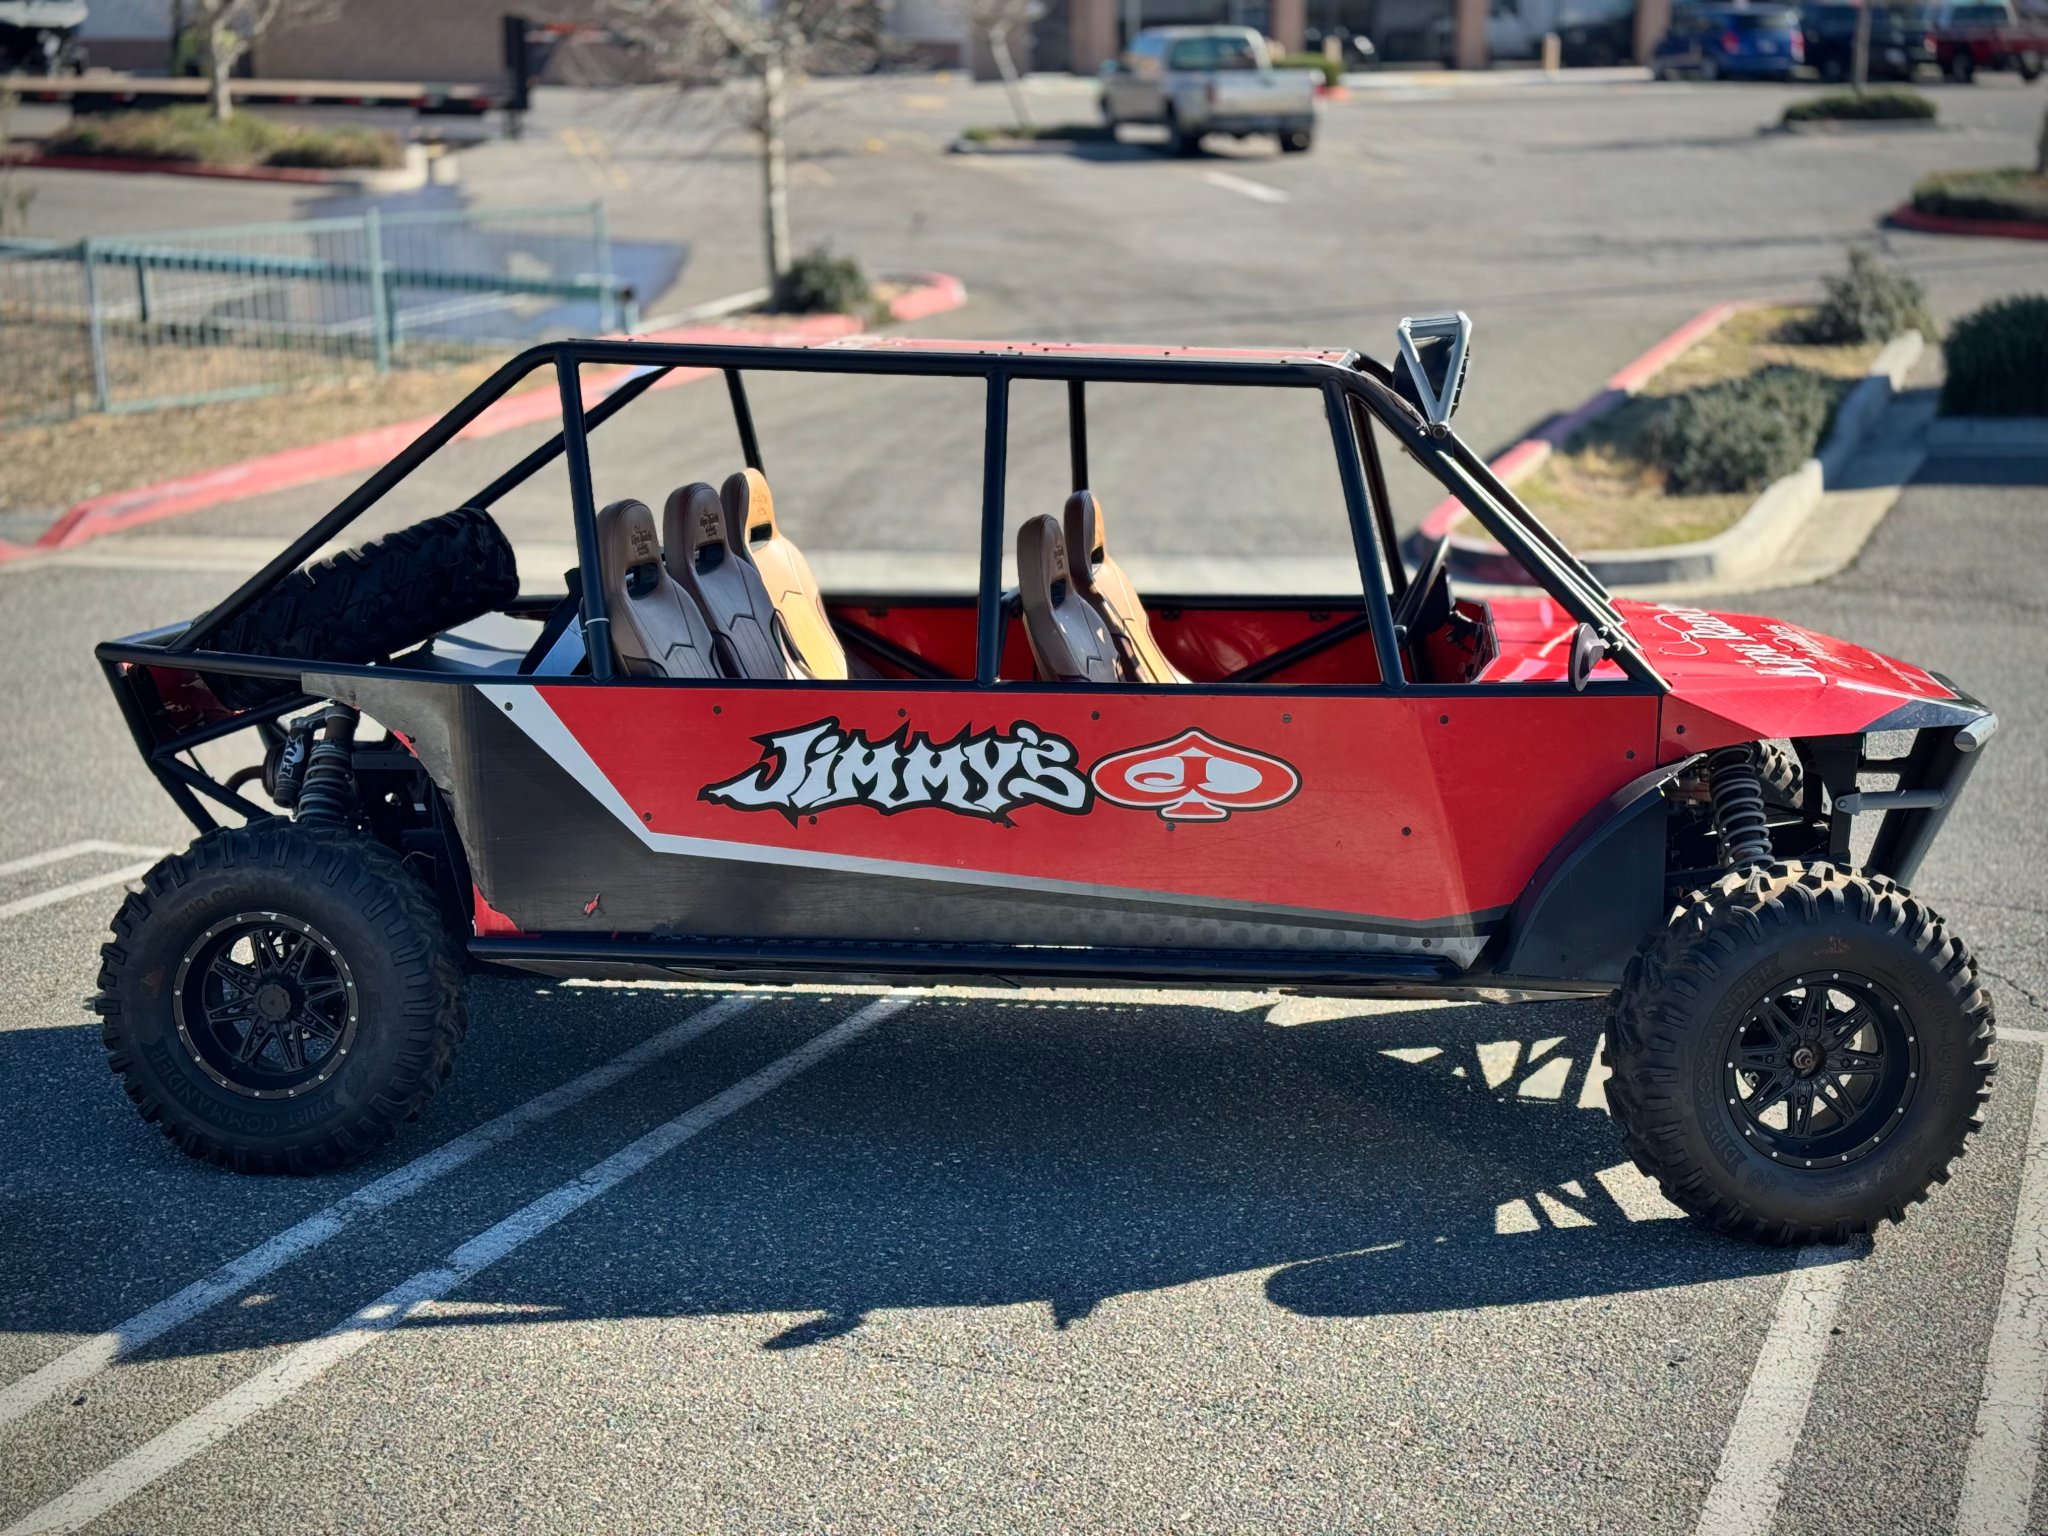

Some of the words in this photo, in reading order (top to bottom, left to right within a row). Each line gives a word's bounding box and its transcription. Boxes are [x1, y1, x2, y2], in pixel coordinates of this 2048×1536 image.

[1697, 963, 1774, 1110] COMMANDER
[150, 1044, 278, 1132] COMMANDER
[287, 1096, 335, 1129] DIRT
[1705, 1119, 1741, 1165] DIRT
